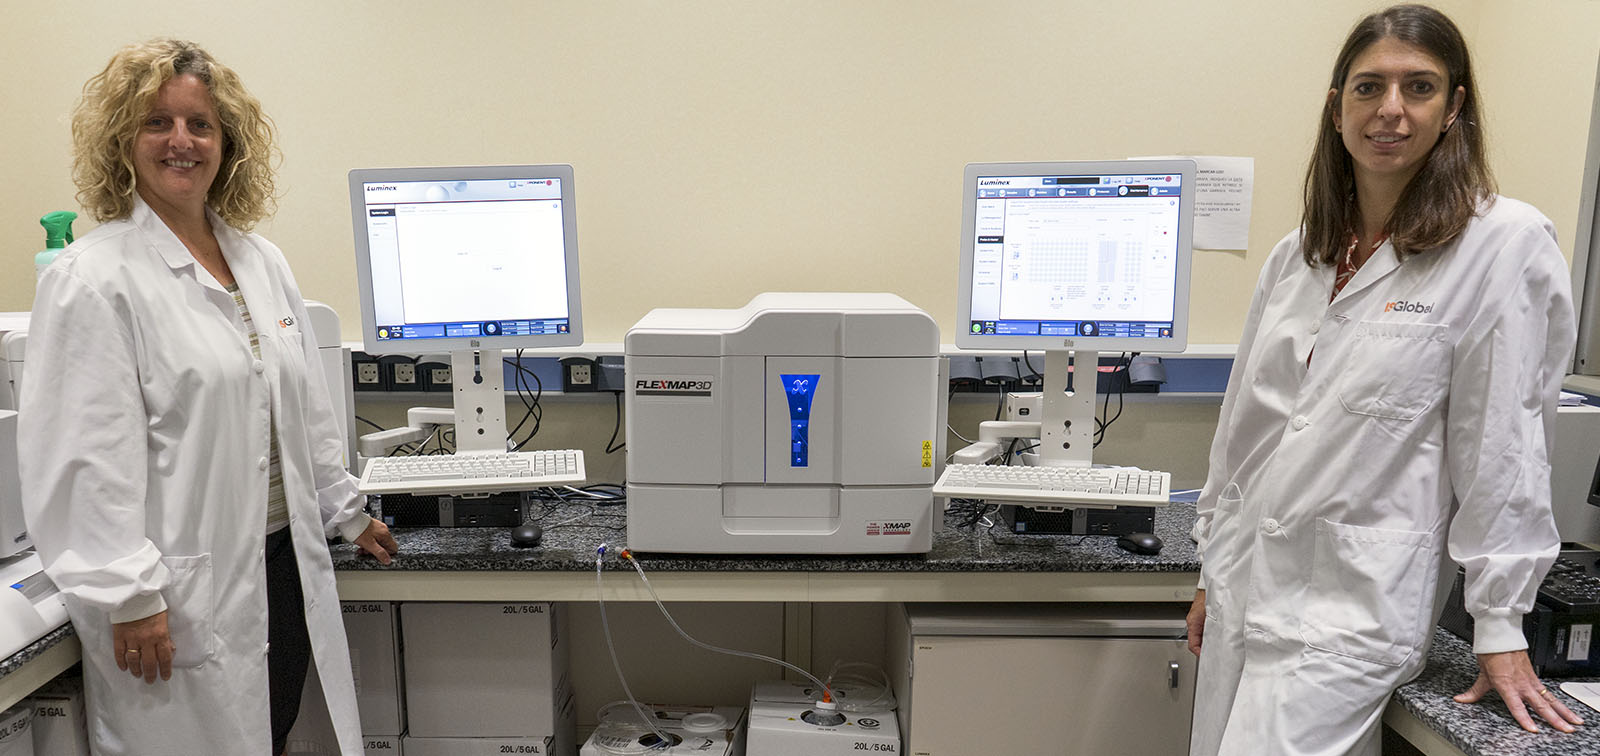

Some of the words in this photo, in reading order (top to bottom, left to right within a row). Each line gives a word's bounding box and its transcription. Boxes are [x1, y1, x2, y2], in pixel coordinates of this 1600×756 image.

[368, 605, 383, 613] GAL
[47, 707, 67, 717] GAL
[376, 741, 391, 749] GAL
[525, 745, 539, 753] GAL
[881, 743, 895, 752] GAL
